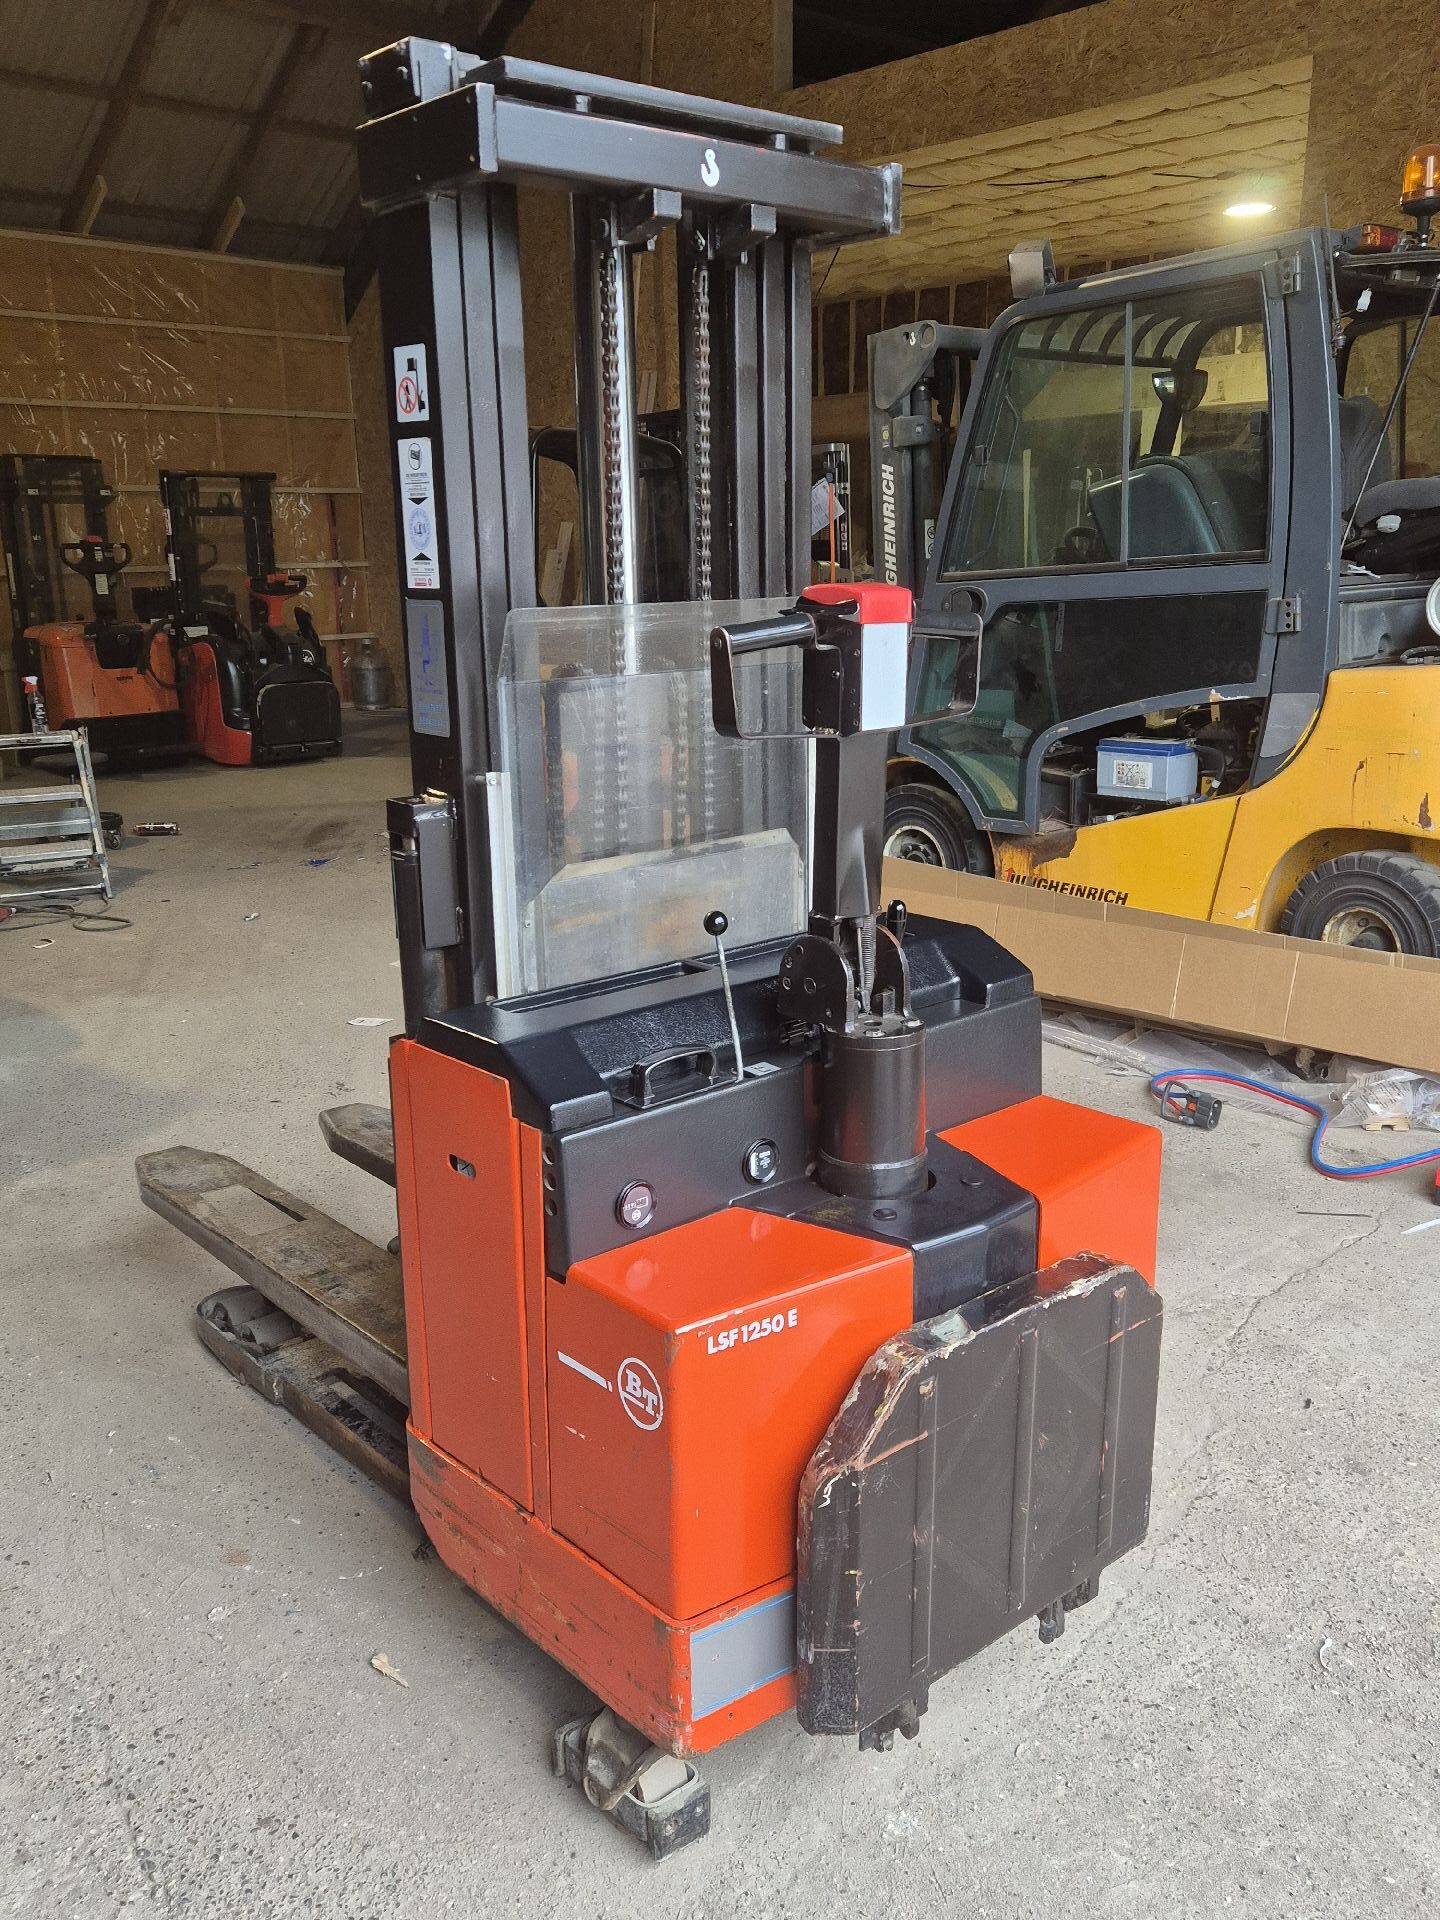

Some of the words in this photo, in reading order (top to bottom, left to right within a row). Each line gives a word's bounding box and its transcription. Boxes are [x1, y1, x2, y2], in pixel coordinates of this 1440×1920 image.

[707, 1328, 739, 1355] LSF
[741, 1313, 785, 1343] 1250
[787, 1307, 798, 1328] E
[624, 1367, 659, 1417] BT
